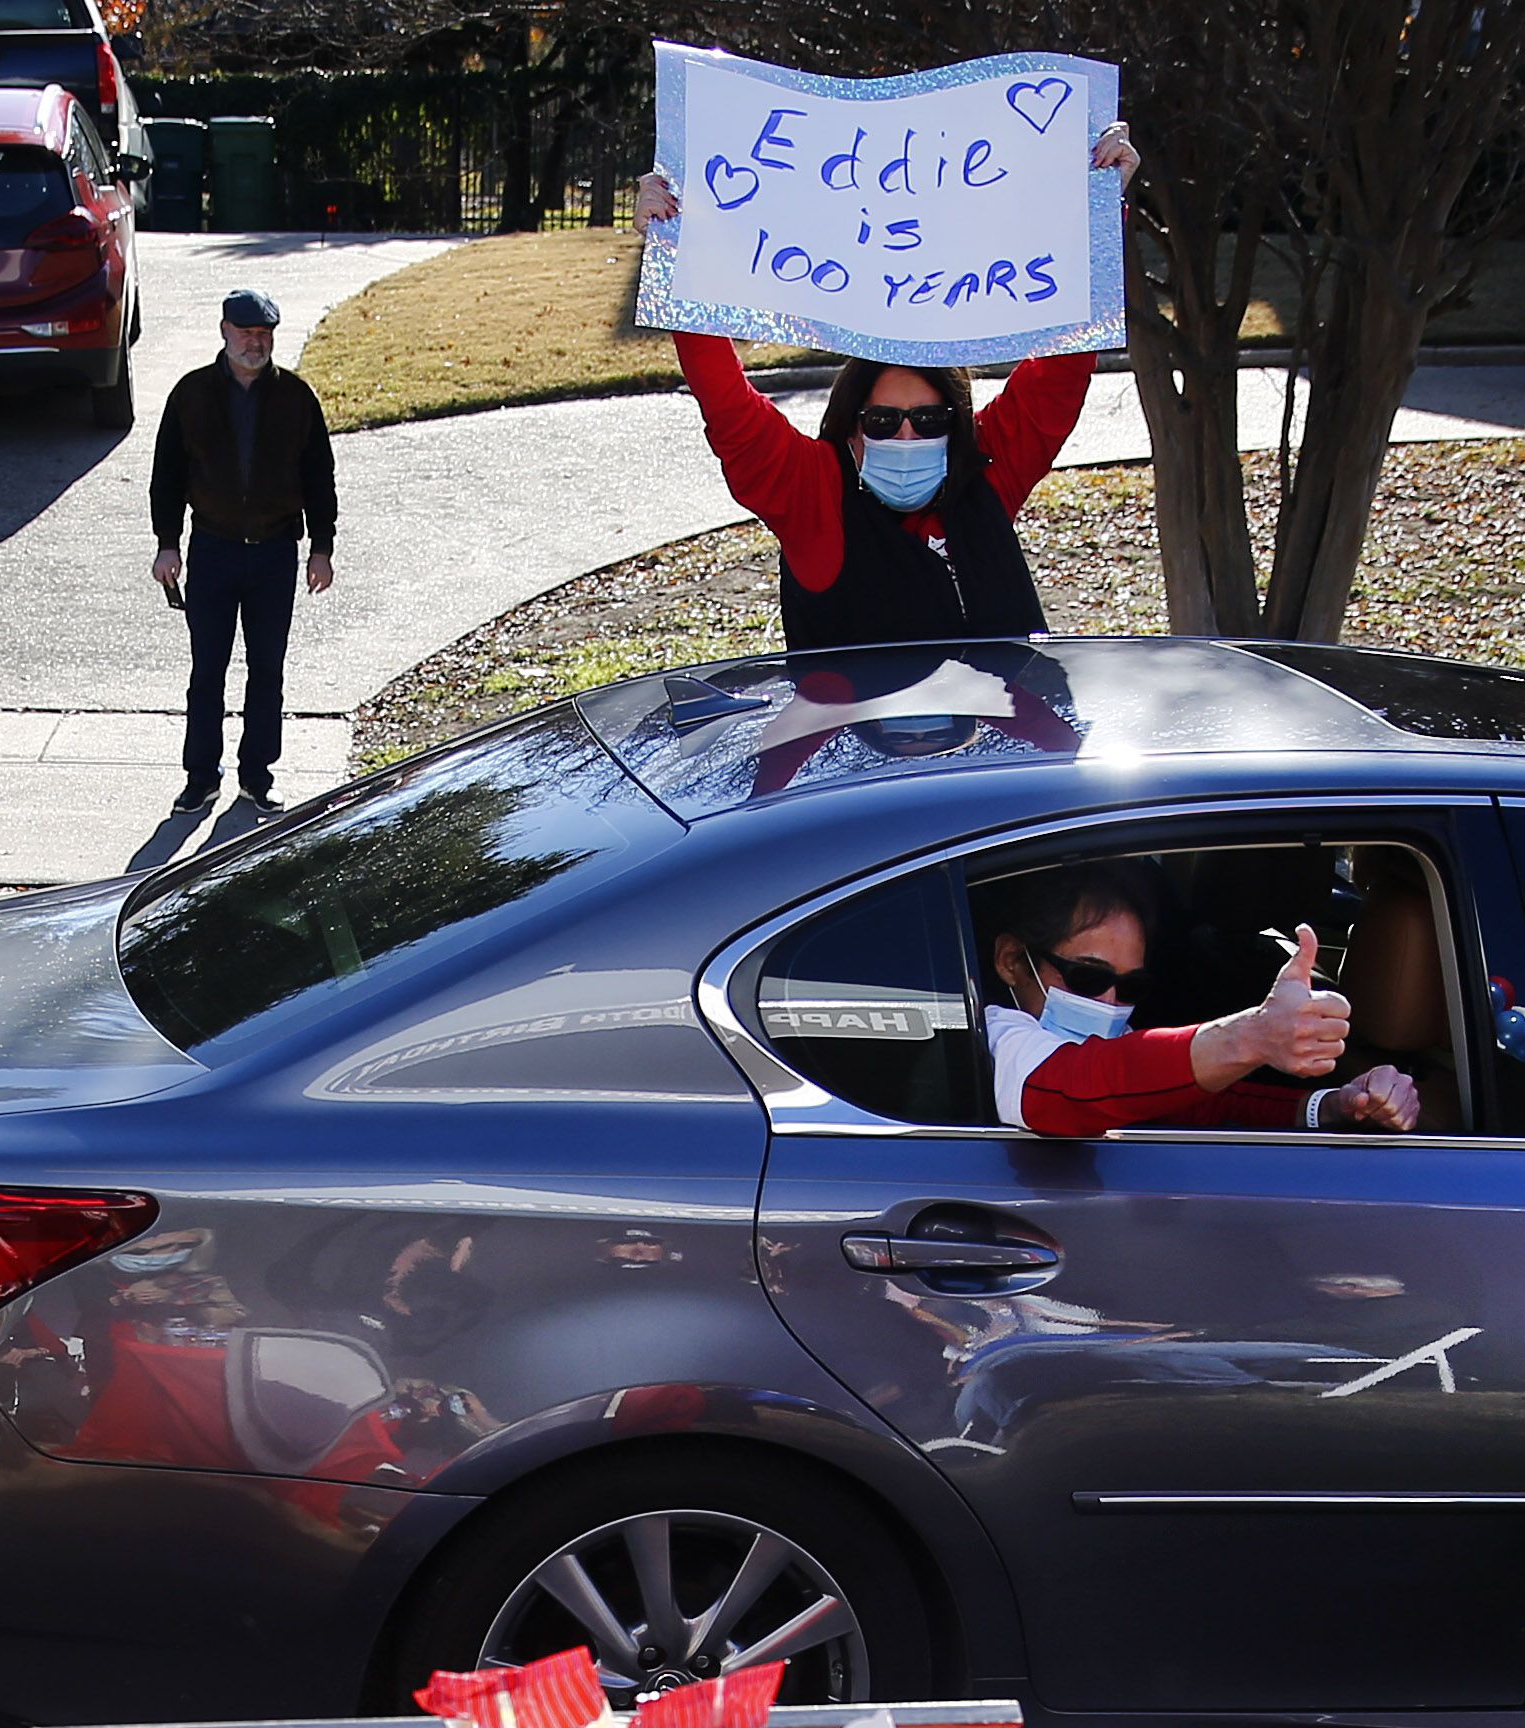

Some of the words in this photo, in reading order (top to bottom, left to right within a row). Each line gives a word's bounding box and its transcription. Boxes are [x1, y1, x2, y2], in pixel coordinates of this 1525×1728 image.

[750, 108, 1009, 195] Eddie
[751, 229, 850, 293] 100
[884, 254, 1058, 308] YEARS
[858, 207, 923, 251] is
